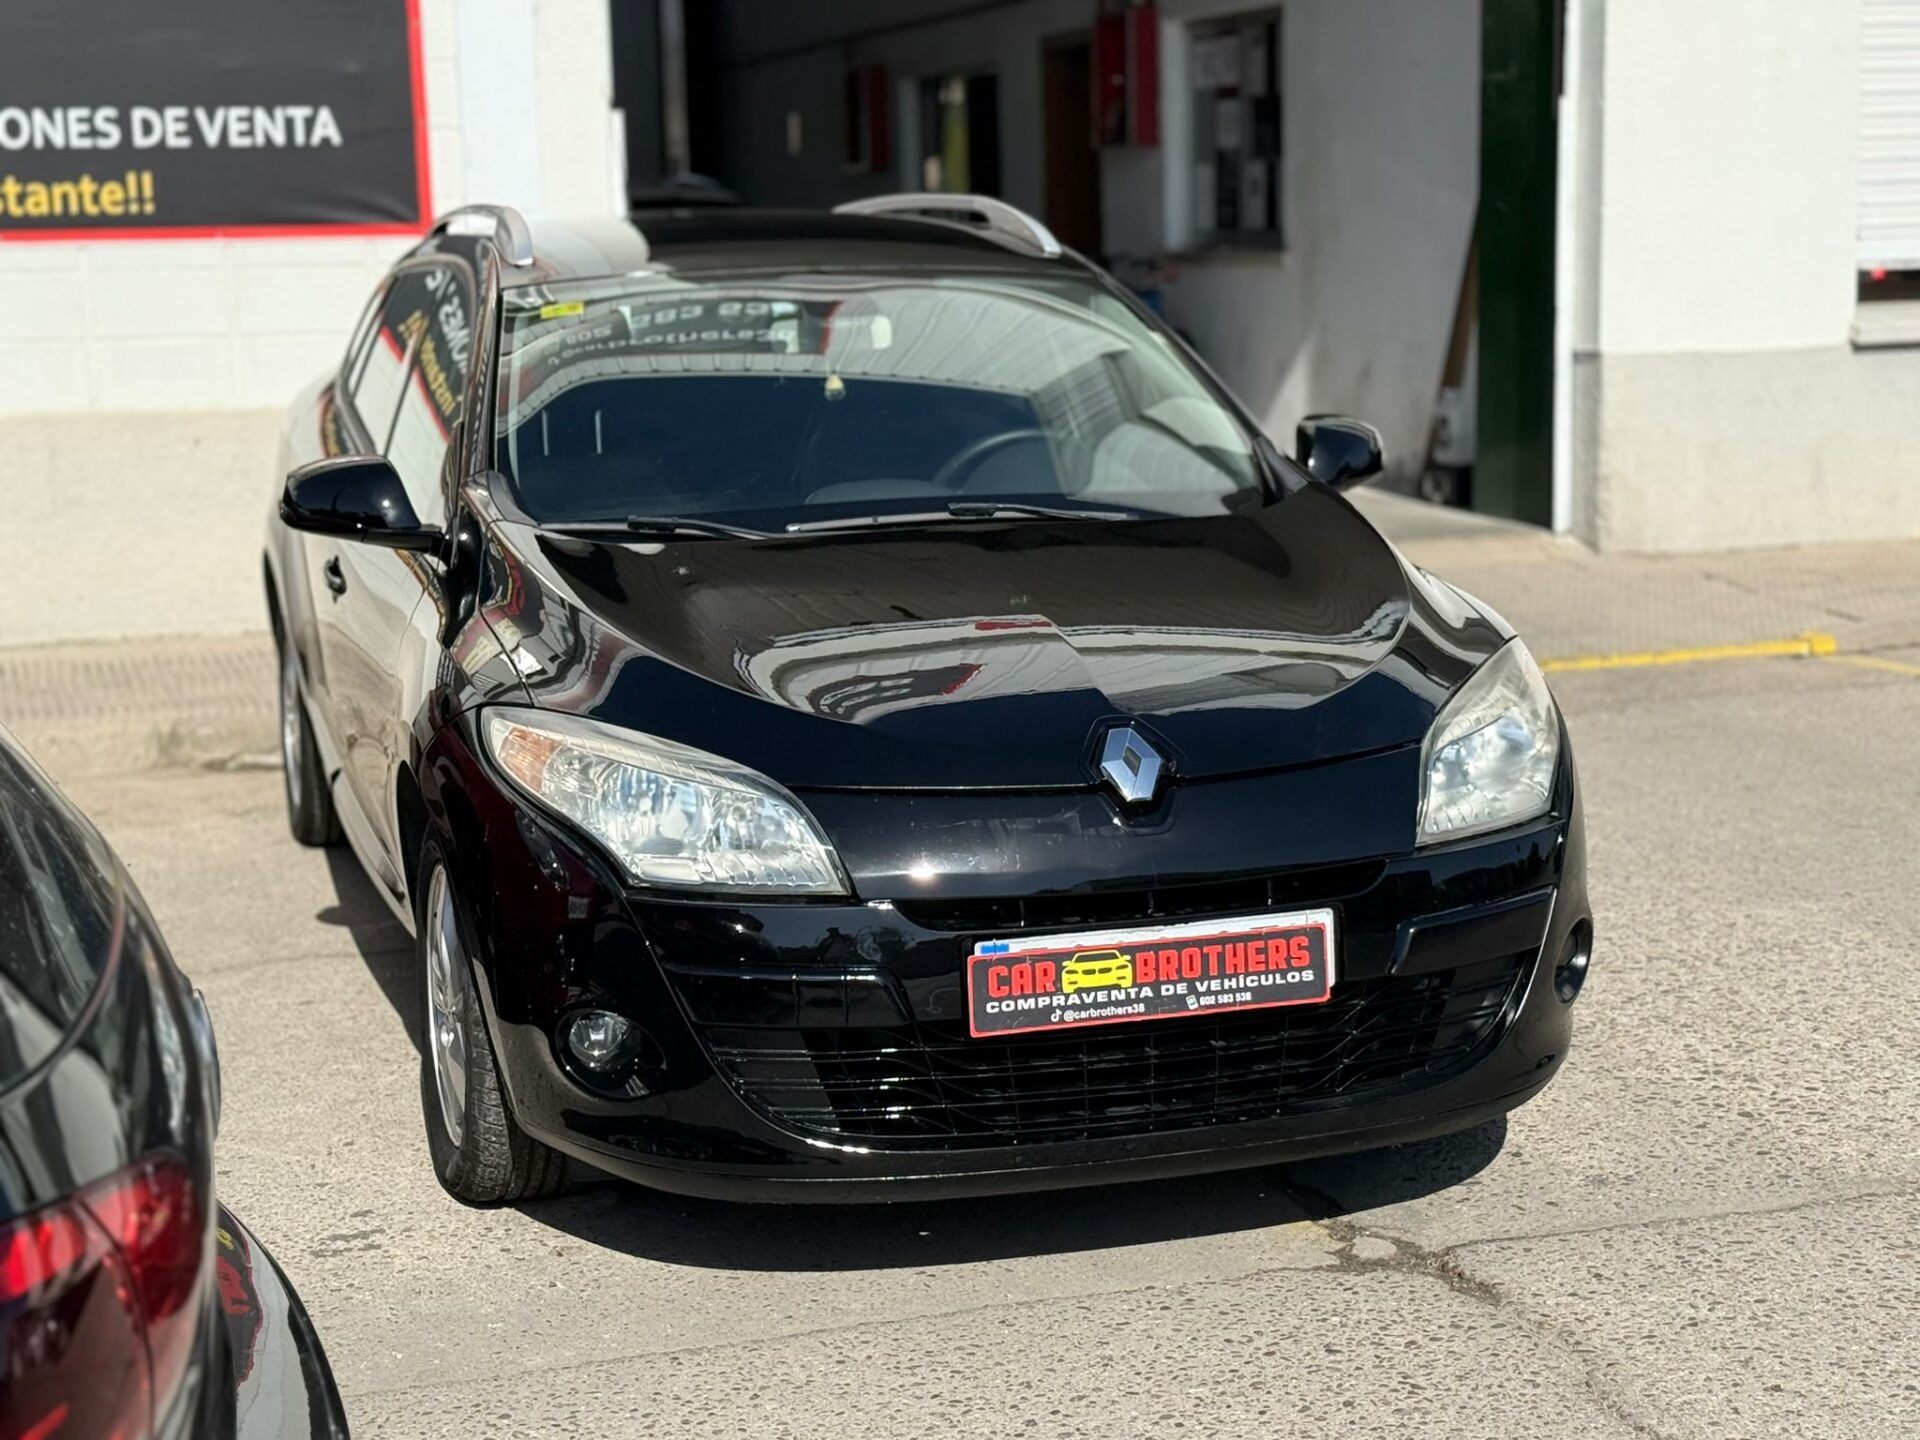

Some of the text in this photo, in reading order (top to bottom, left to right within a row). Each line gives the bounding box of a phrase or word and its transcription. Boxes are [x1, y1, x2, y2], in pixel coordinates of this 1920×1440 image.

[131, 106, 192, 149] DE
[194, 105, 343, 149] VENTA
[0, 171, 156, 217] tante!!
[987, 936, 1310, 998] CAR BROTHERS
[985, 969, 1316, 1014] COMPRAVENTA DE VEHÍCULOS
[1063, 1003, 1146, 1022] @carbrothers38
